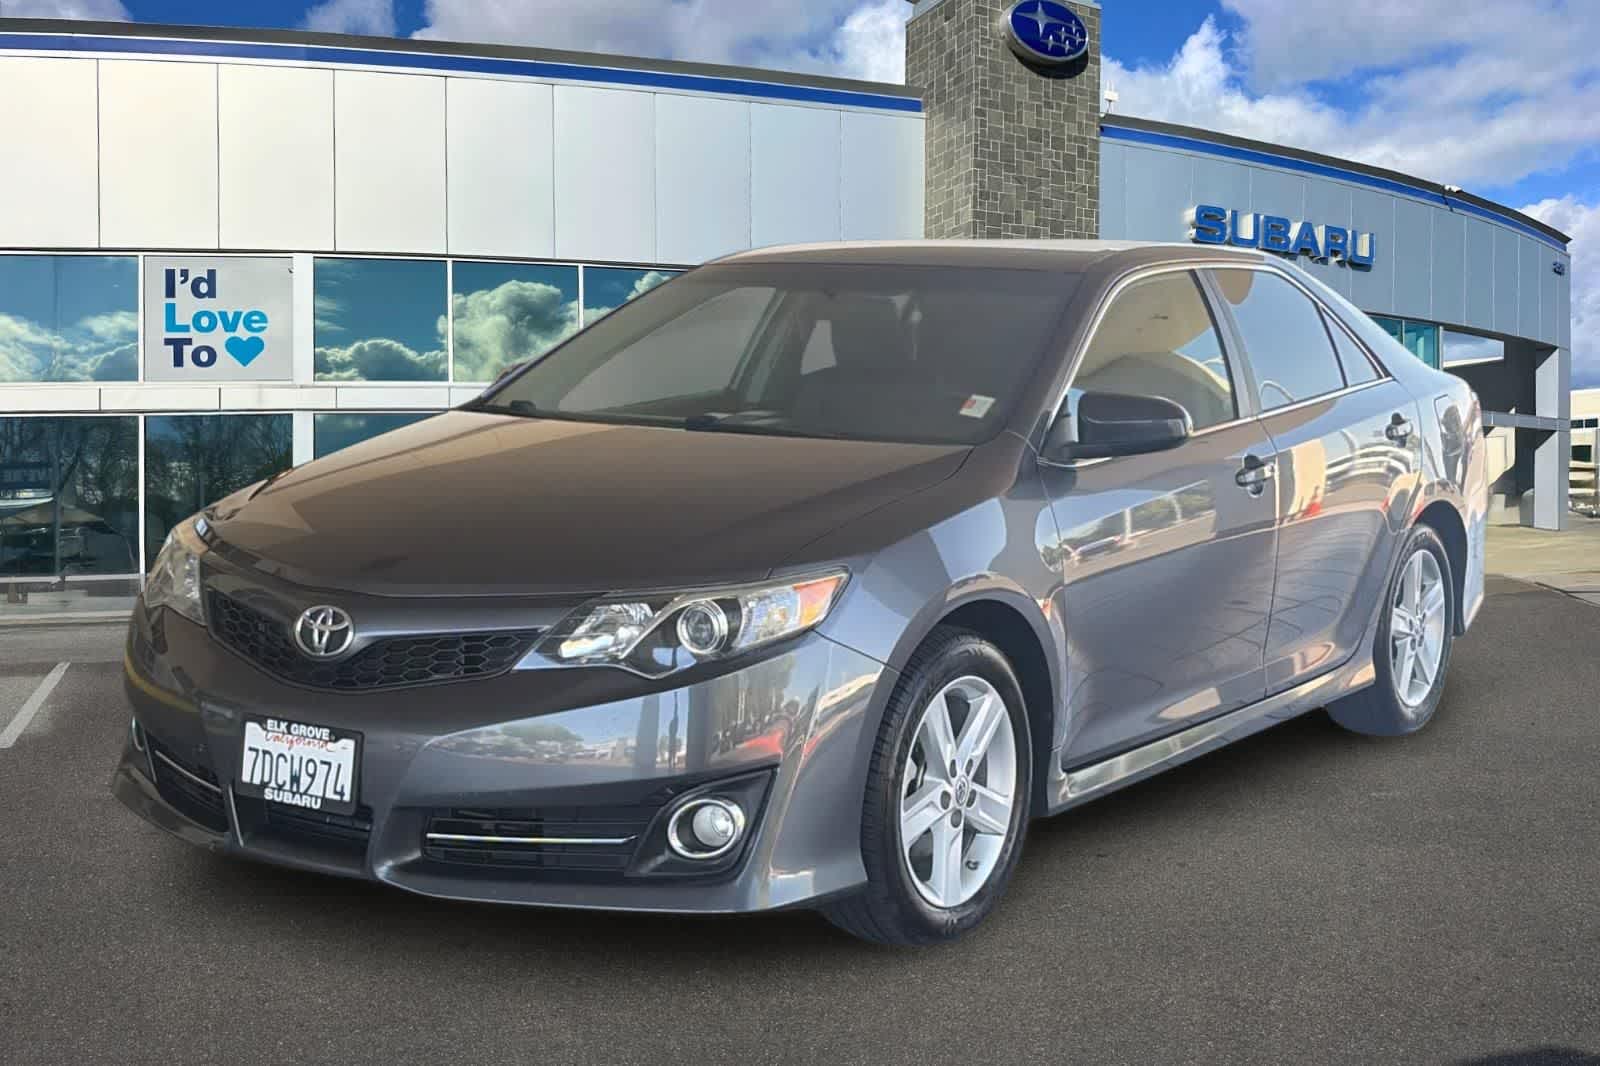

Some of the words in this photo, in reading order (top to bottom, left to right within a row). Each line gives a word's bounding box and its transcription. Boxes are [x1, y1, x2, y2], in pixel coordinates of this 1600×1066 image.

[1191, 204, 1376, 267] SUBARU
[164, 302, 268, 333] Love
[163, 337, 217, 368] To
[266, 718, 288, 733] ELK
[290, 723, 330, 740] GROVE
[247, 746, 346, 800] 7DCW974
[264, 788, 321, 809] SUBARU
